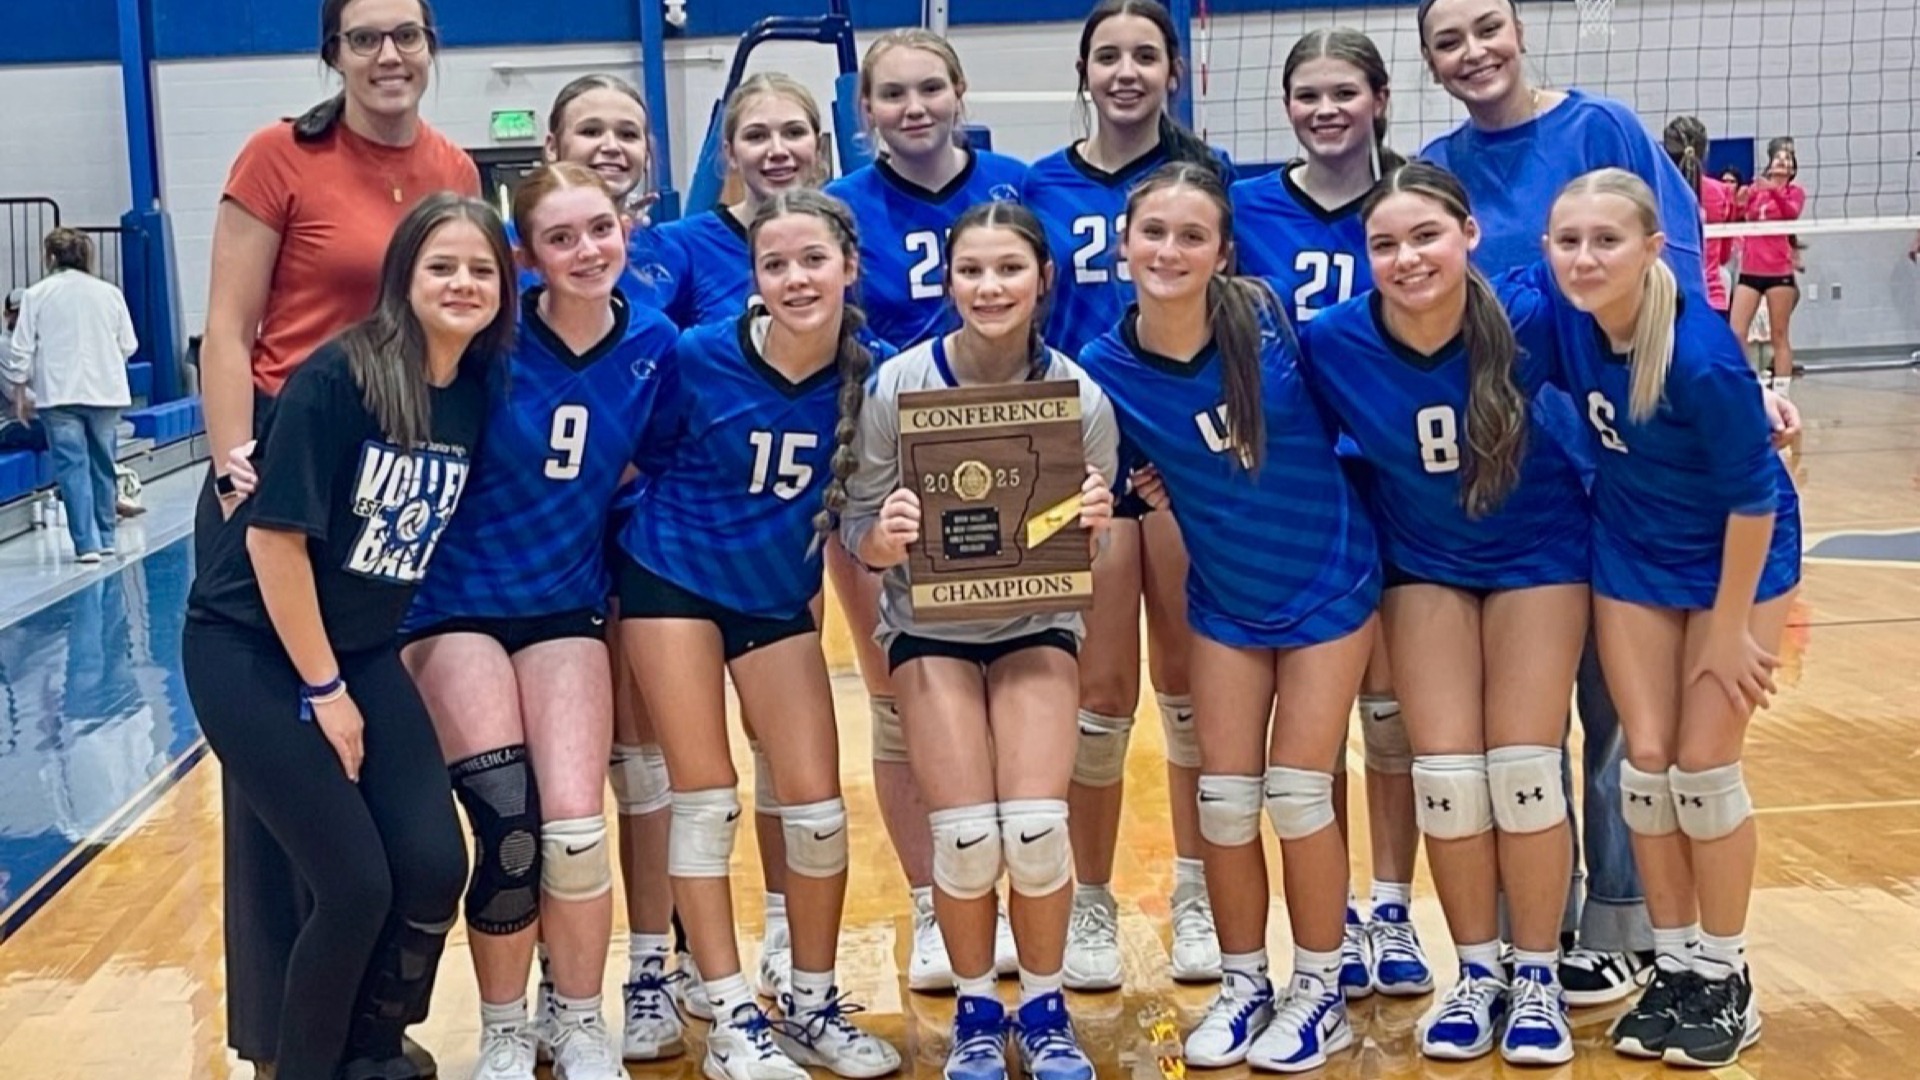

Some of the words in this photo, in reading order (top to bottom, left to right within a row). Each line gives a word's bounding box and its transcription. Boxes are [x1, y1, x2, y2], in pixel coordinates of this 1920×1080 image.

[905, 228, 952, 300] 2
[1294, 251, 1354, 321] 21
[544, 405, 589, 480] 9
[912, 400, 1069, 428] CONFERENCE
[1416, 405, 1460, 473] 8
[748, 431, 818, 500] 15
[923, 473, 949, 493] 20
[995, 468, 1020, 488] 25
[932, 576, 1074, 603] CHAMPIONS
